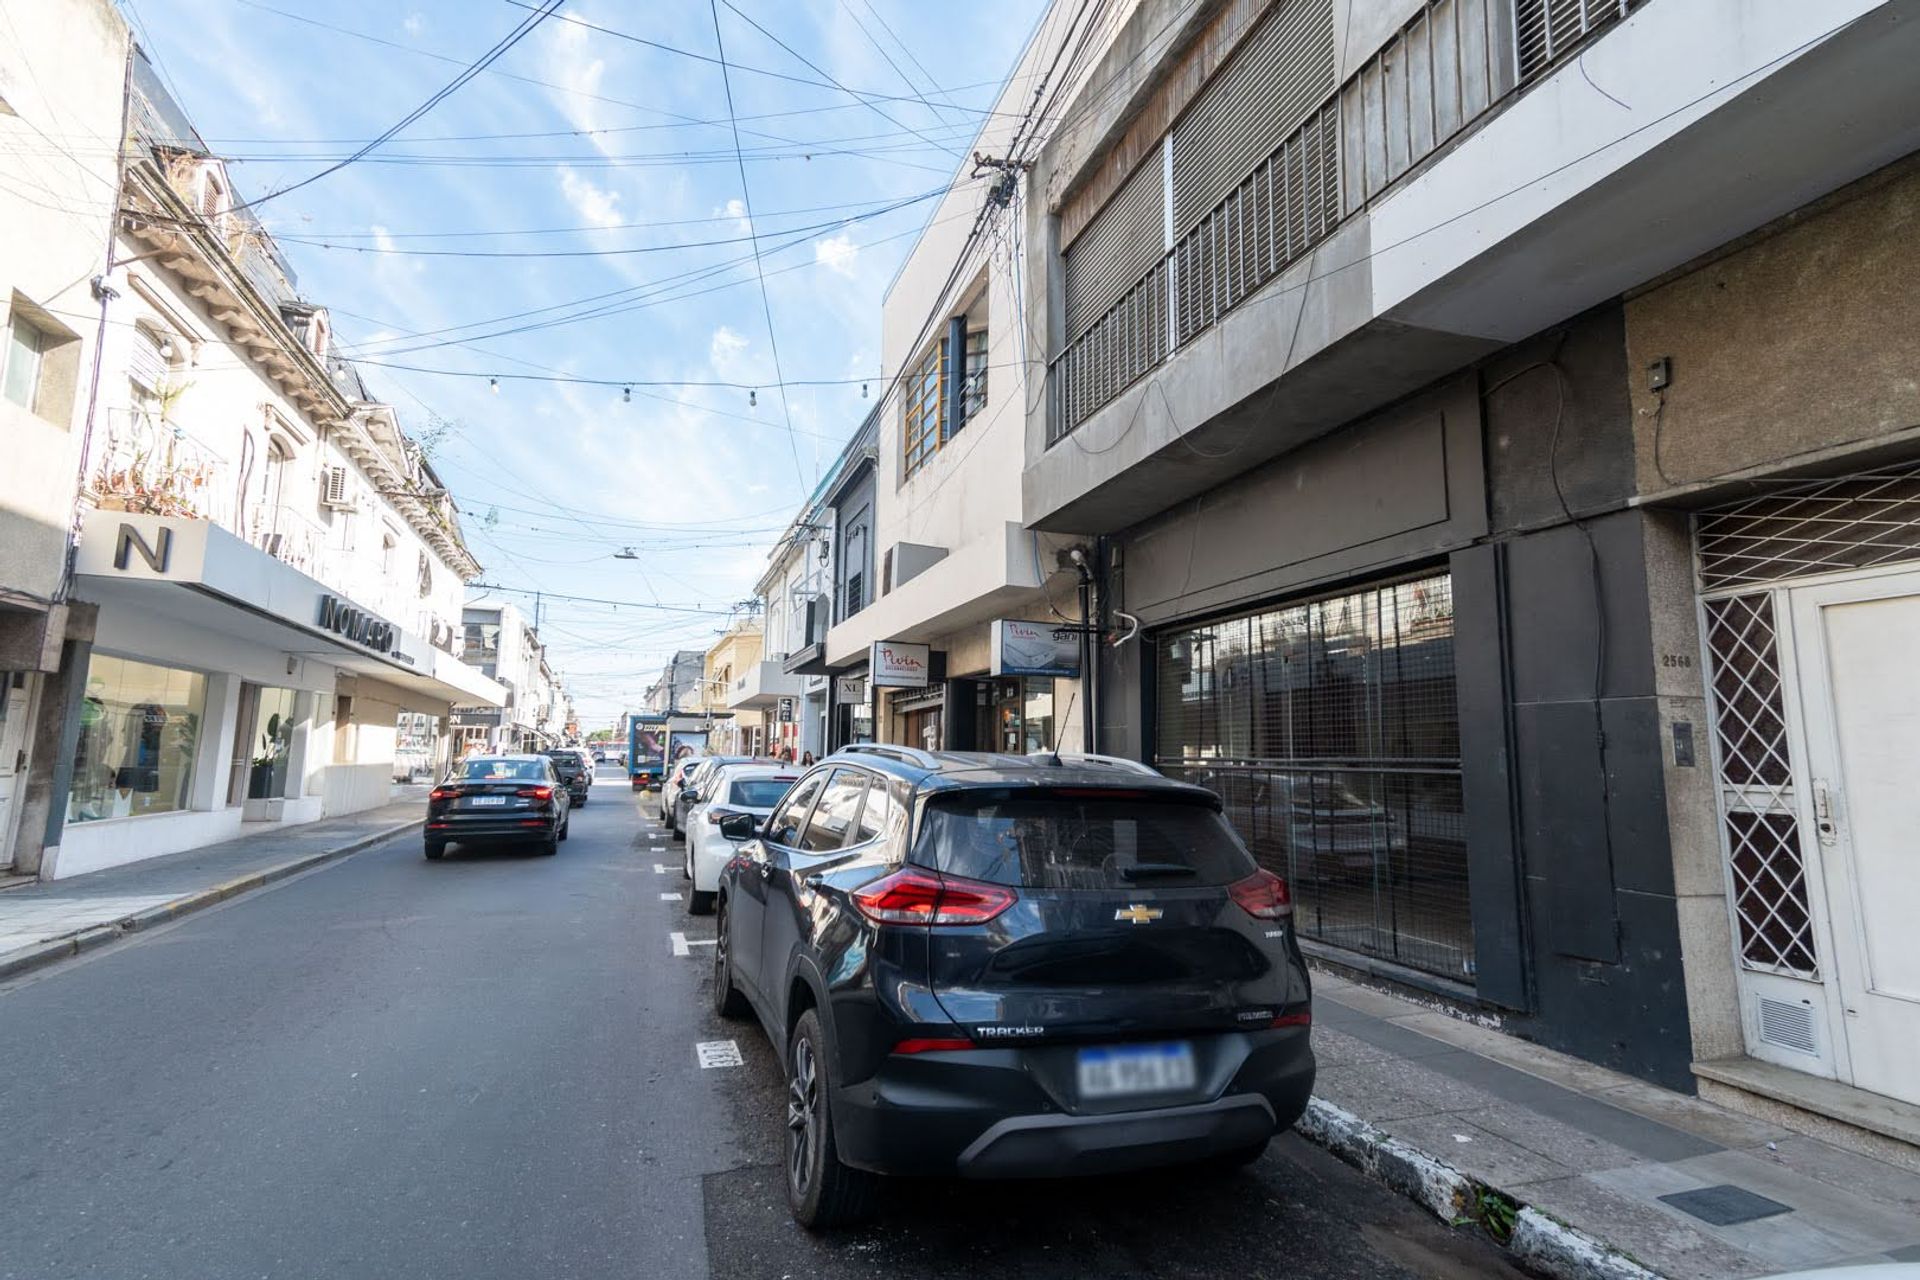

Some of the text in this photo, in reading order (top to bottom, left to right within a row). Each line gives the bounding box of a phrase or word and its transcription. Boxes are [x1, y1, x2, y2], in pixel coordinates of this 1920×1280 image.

[114, 522, 171, 574] N
[1662, 655, 1693, 668] 2568
[977, 1027, 1044, 1037] TRACKER
